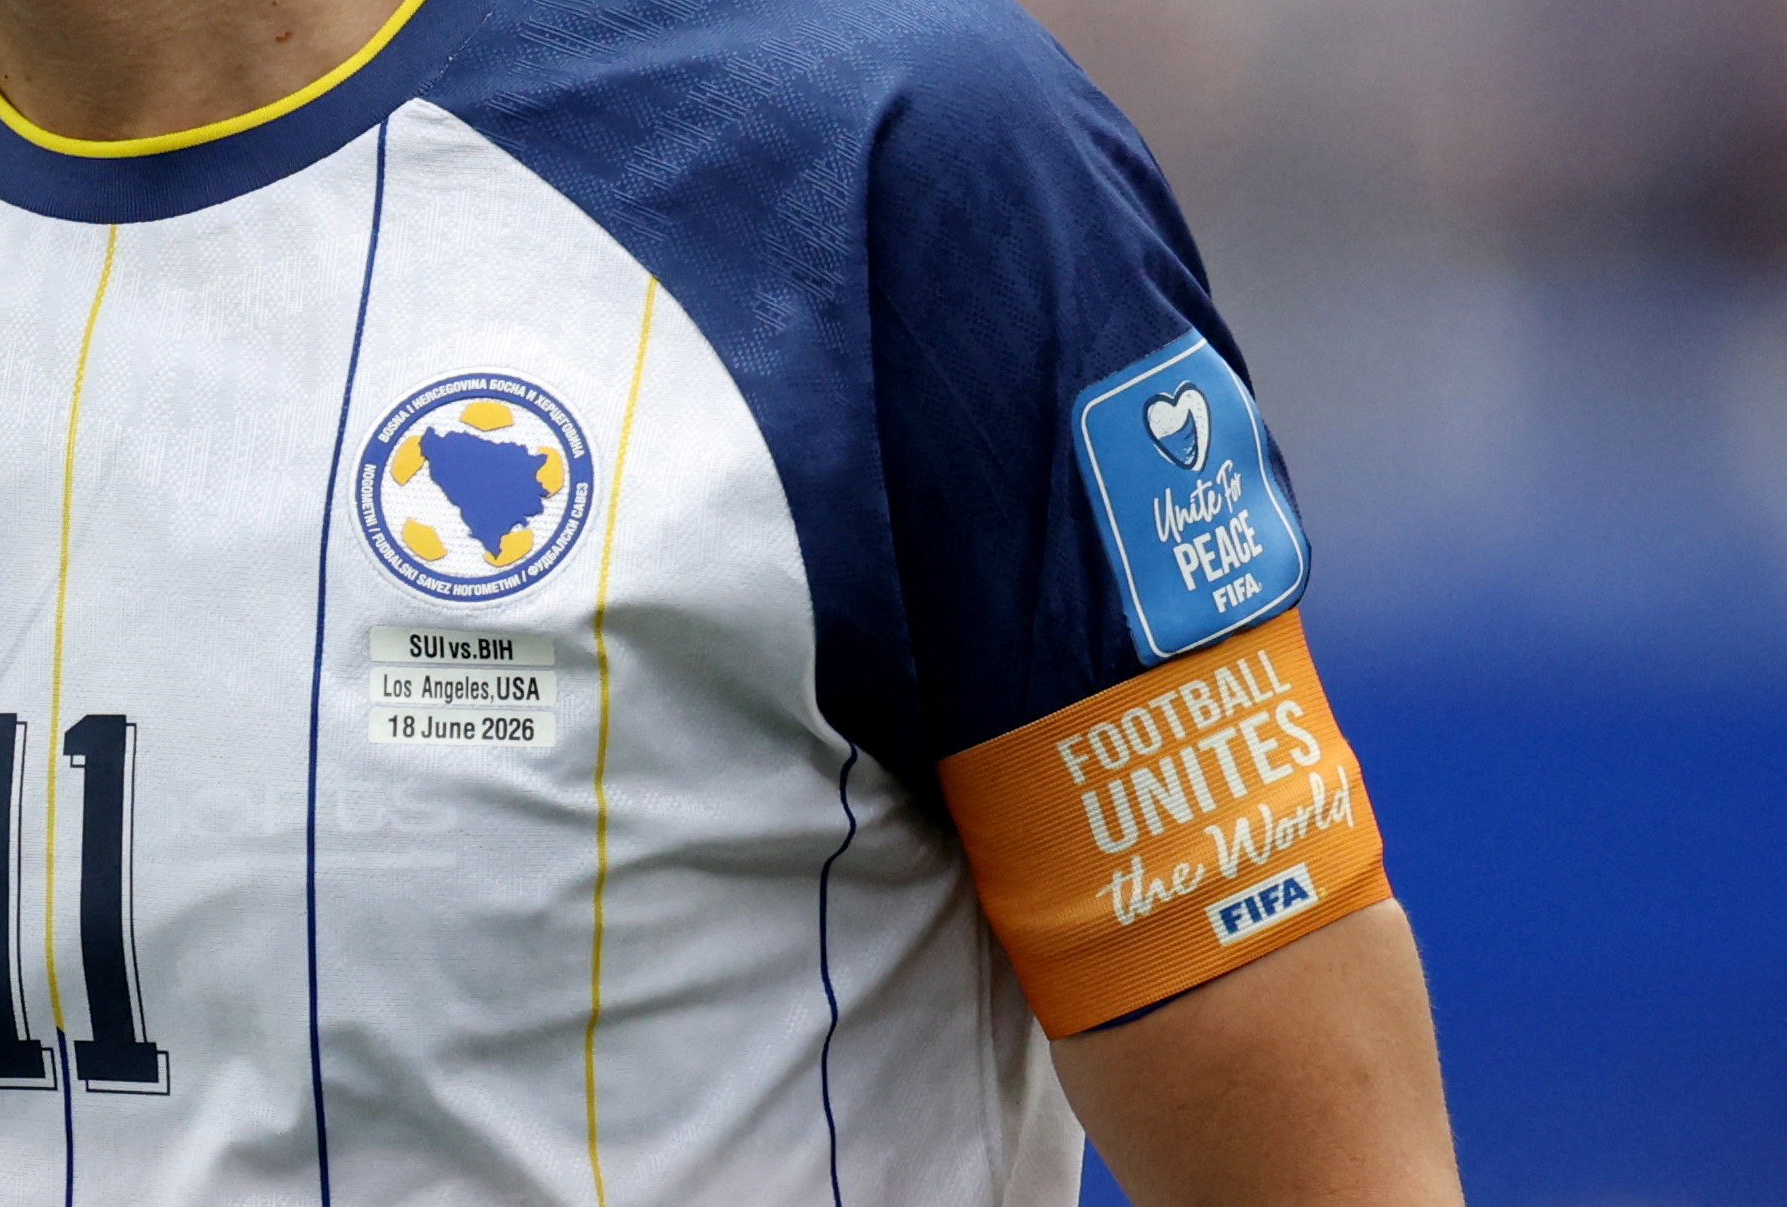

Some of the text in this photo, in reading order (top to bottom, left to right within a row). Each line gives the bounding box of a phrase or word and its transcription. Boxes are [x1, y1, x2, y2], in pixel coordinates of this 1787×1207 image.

[378, 378, 487, 443] BOSNA I HERCEGOVINA
[489, 378, 526, 397] БОСНА
[525, 389, 537, 401] И
[361, 463, 378, 527] NOGOMETNI
[371, 532, 419, 581] FUDBALSKI
[416, 573, 453, 595] SAVEZ
[571, 482, 589, 519] САВЕЗ
[1154, 459, 1242, 543] Unite For
[1173, 509, 1263, 591] PEACE
[1212, 572, 1261, 613] FIFA
[409, 634, 444, 658] SUI
[383, 674, 412, 698] Los
[1056, 649, 1292, 784] FOOTBALL
[388, 714, 535, 741] 18 June 2026
[1080, 700, 1322, 854] UNITES
[1096, 765, 1354, 926] the World
[1218, 876, 1310, 935] FIFA
